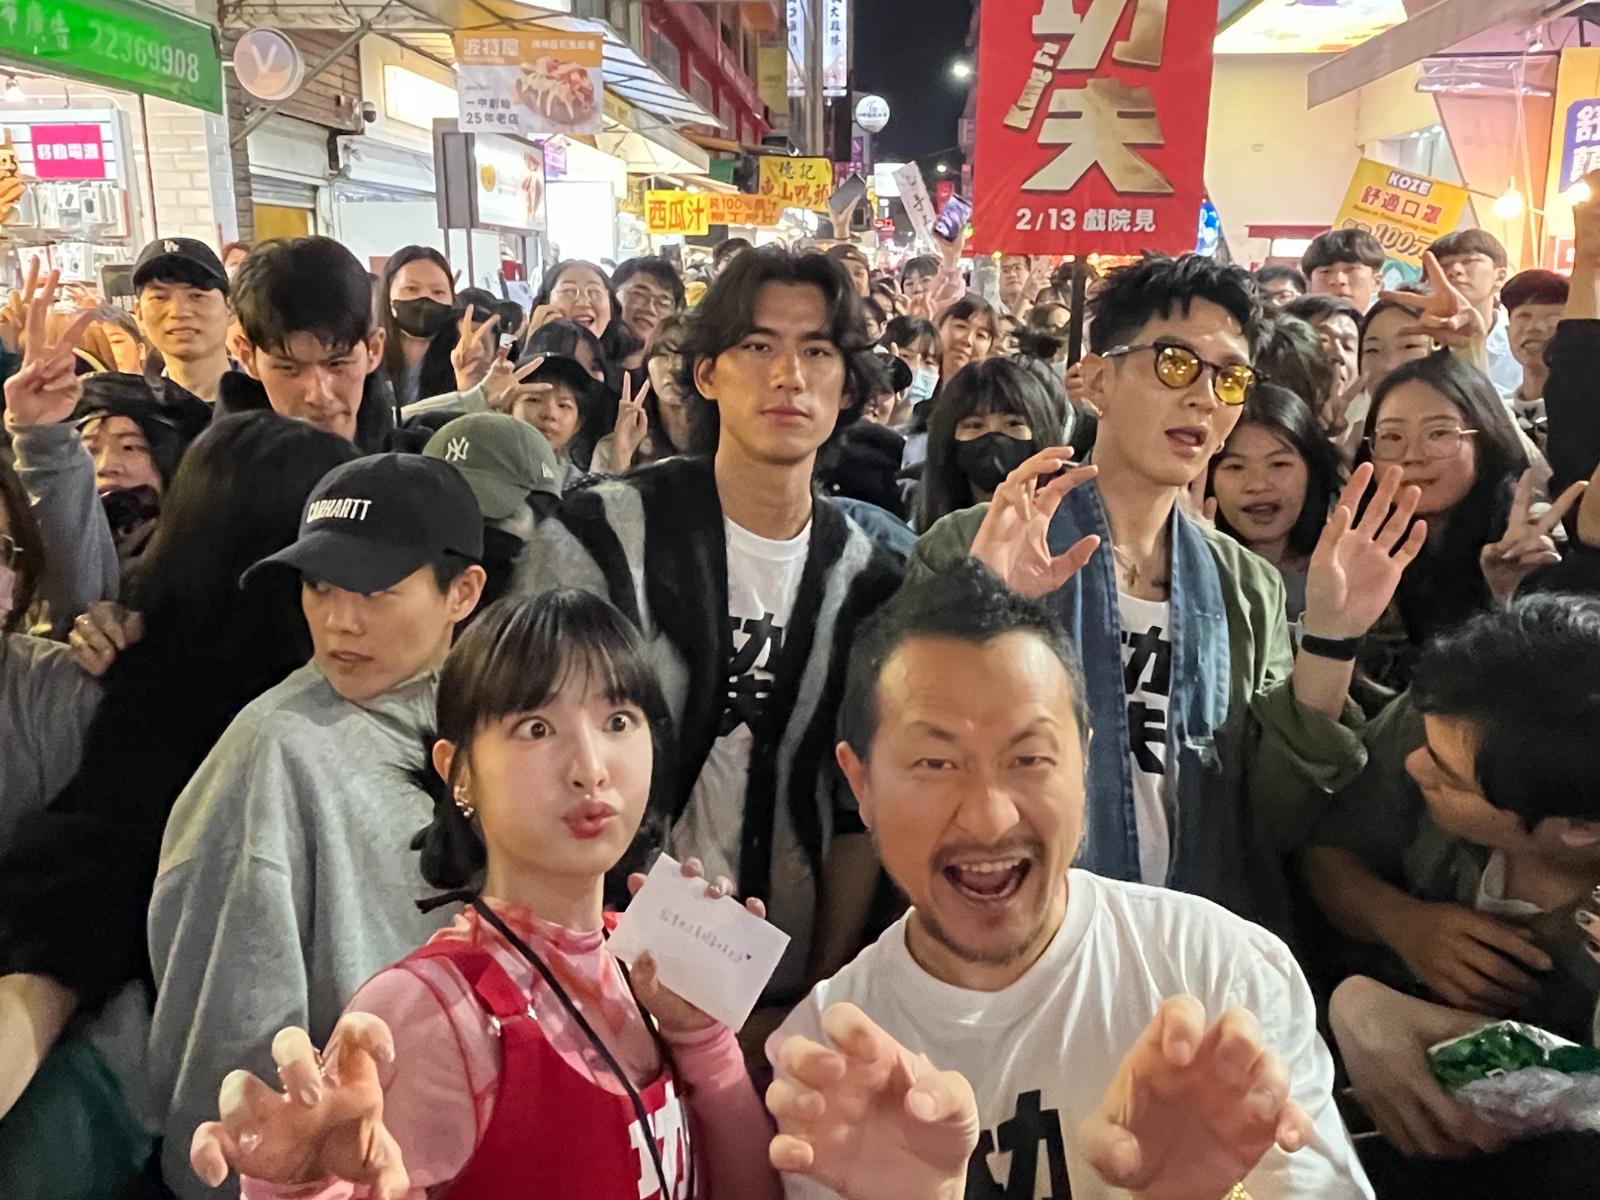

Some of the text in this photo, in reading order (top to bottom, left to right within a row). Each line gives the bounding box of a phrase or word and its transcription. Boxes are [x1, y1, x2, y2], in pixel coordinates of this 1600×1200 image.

[88, 20, 200, 83] 22369908
[466, 112, 519, 125] 25年老店
[1388, 172, 1432, 196] KOZE
[650, 200, 704, 230] 西瓜汁
[1361, 185, 1442, 225] 舒適口罩
[1016, 207, 1156, 232] 2/13 戲院見
[445, 436, 470, 461] NY
[306, 497, 373, 524] CARHARTT
